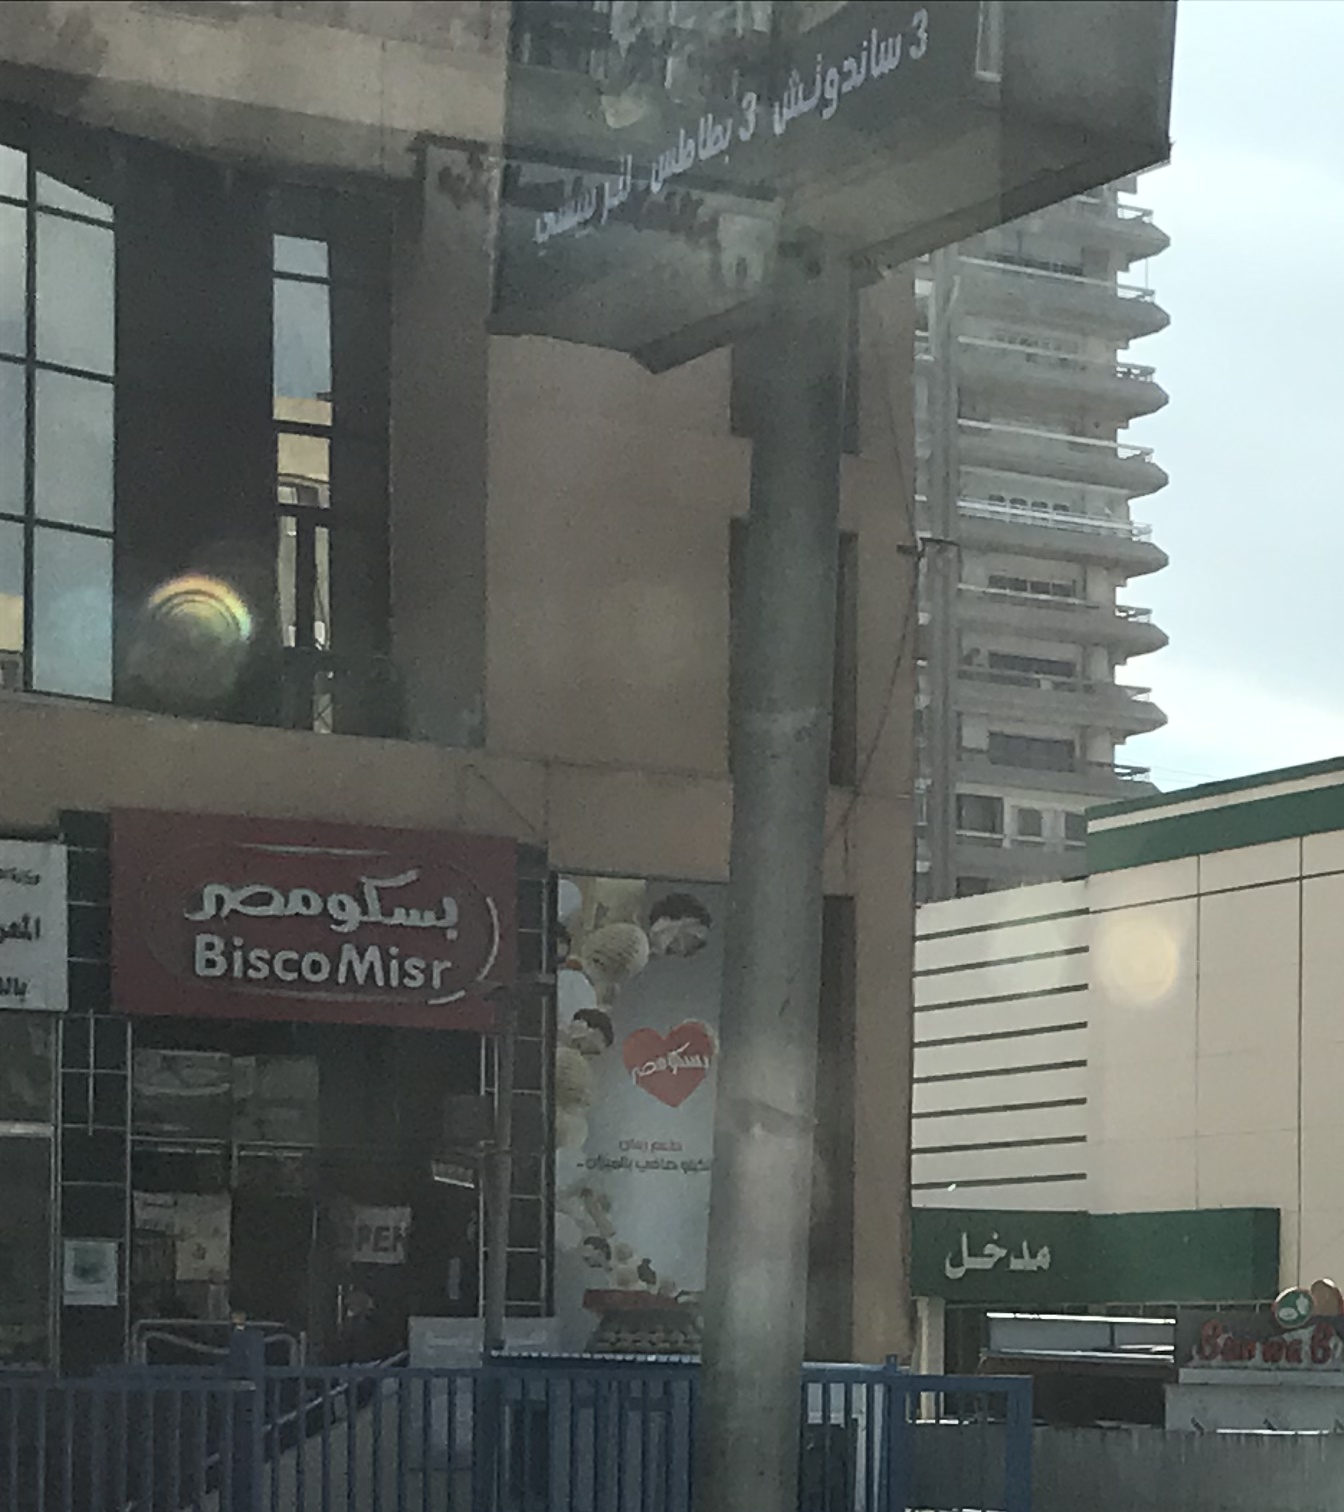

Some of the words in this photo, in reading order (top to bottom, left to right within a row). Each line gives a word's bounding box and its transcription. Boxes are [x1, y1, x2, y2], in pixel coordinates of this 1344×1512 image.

[909, 7, 929, 60] 3
[773, 27, 902, 136] ساندوتش
[738, 91, 757, 142] 3
[650, 112, 733, 194] بطاطس
[944, 1230, 1052, 1280] مدخل
